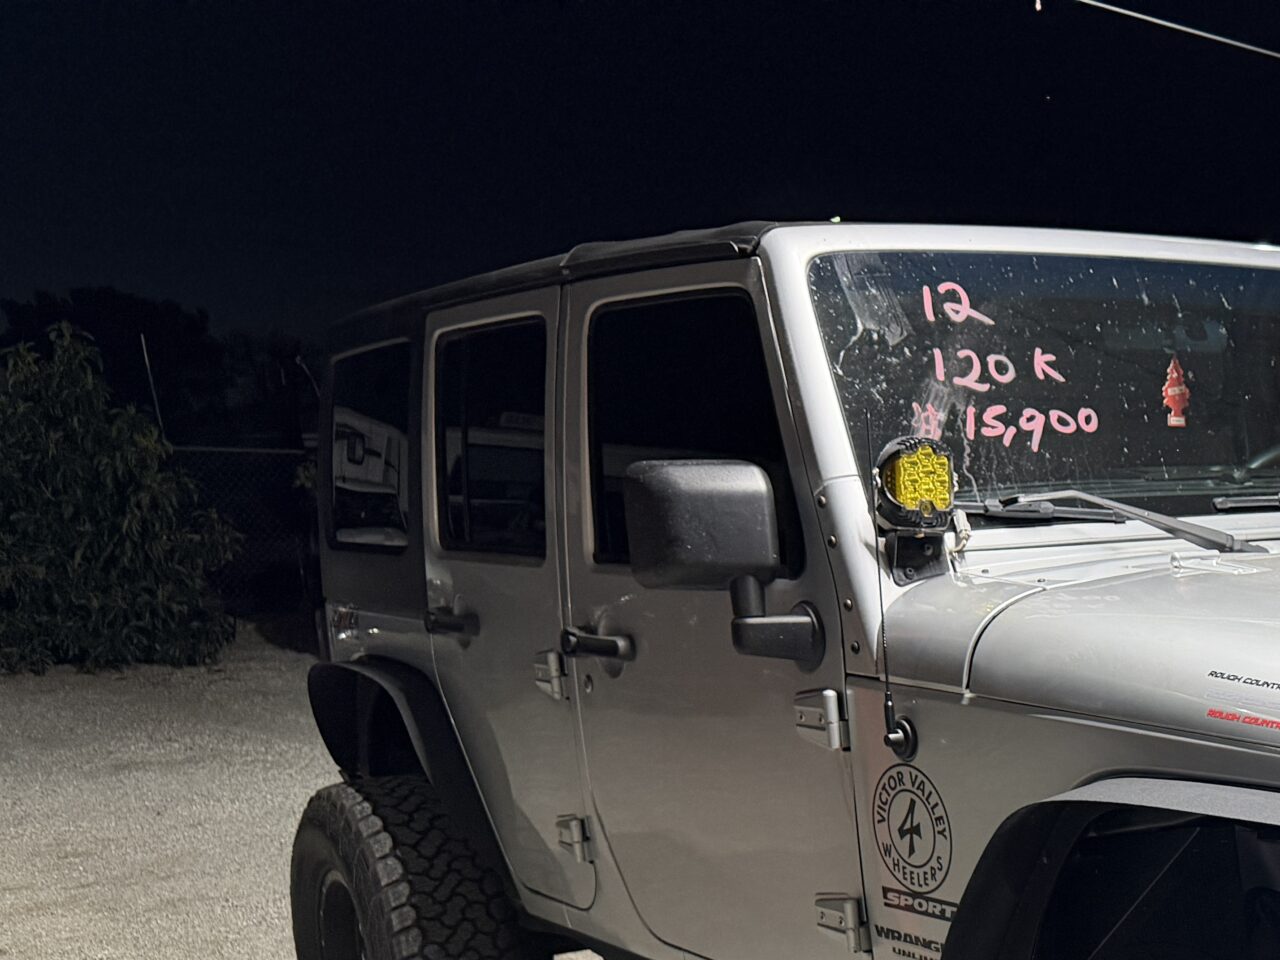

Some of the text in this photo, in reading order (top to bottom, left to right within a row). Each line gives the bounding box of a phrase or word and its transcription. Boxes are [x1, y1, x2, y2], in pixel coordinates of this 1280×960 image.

[923, 281, 995, 326] 12
[933, 347, 1017, 392] 120
[1207, 670, 1243, 682] ROUGH
[1206, 708, 1241, 723] ROUGH
[877, 770, 948, 840] VICTOR VALLEY
[897, 797, 922, 859] 4
[882, 841, 943, 888] WHEELERS
[886, 891, 957, 918] SPORT
[874, 924, 943, 953] WRANG
